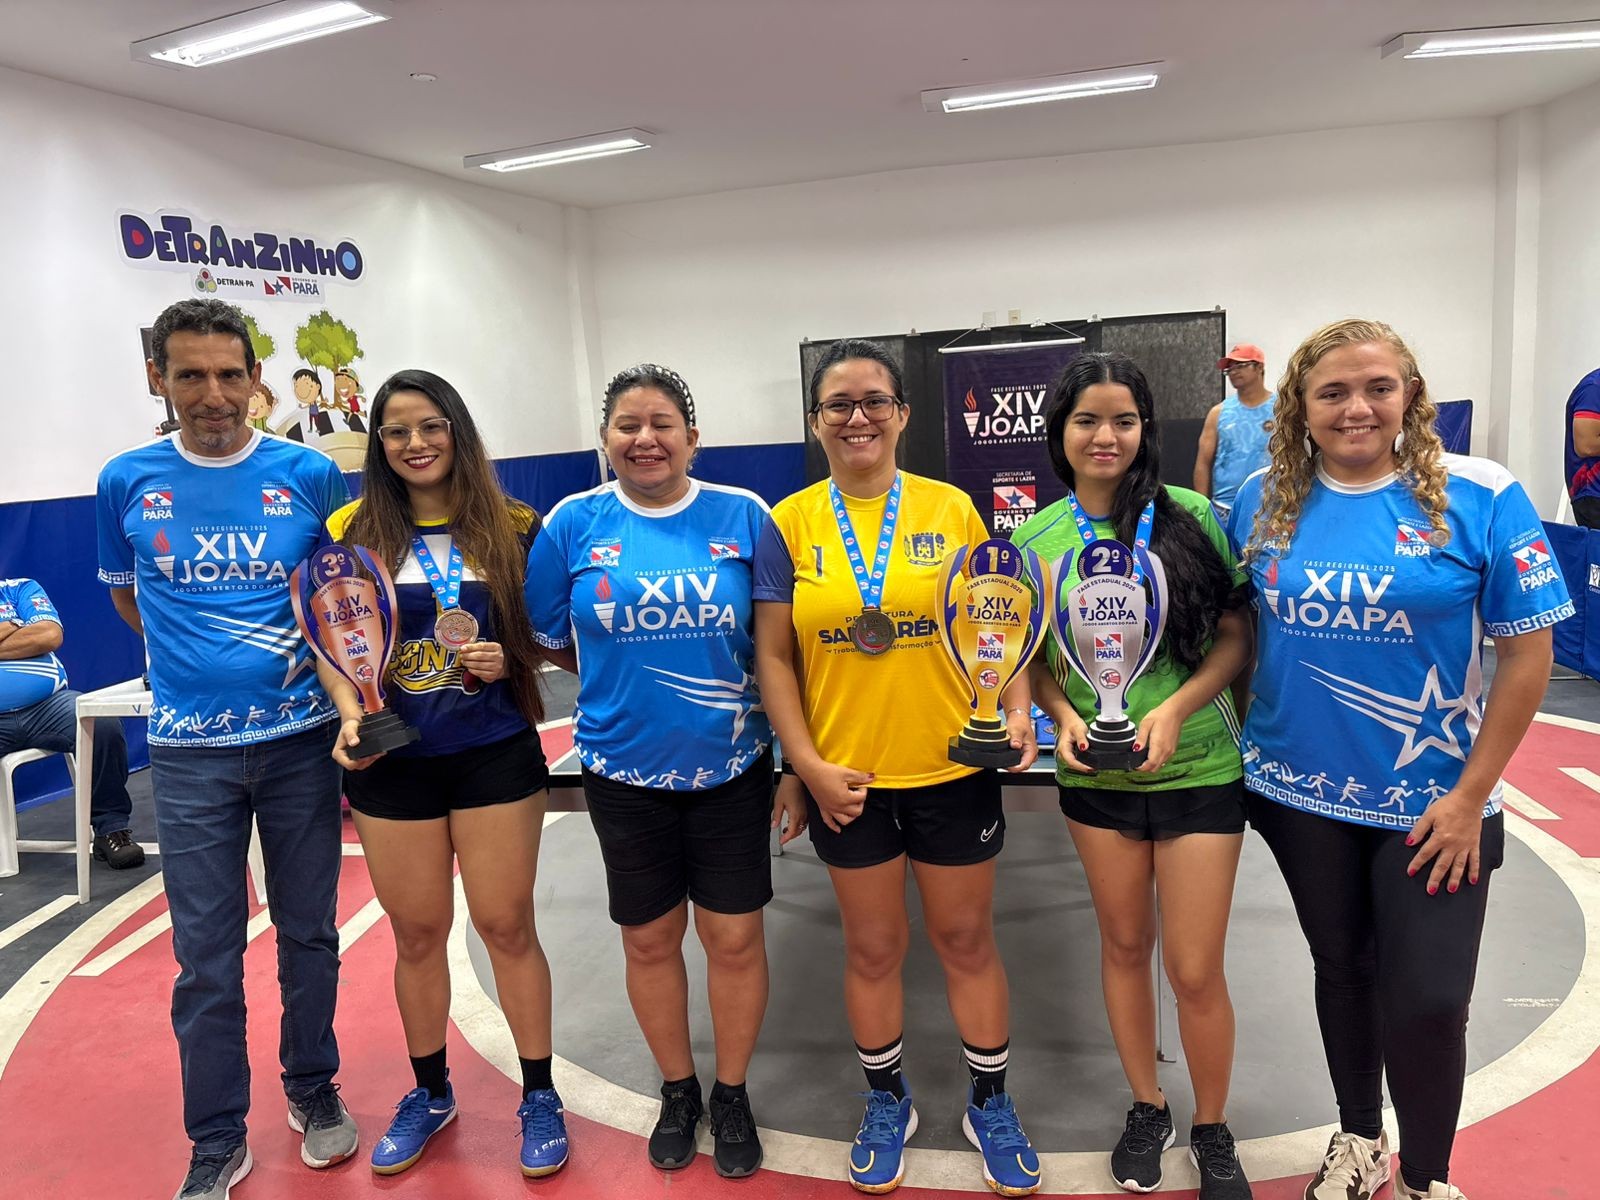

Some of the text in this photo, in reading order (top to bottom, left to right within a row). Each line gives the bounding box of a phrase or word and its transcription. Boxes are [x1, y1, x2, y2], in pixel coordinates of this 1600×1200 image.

[120, 214, 362, 280] DETRANZINHO
[217, 278, 254, 288] DETRAN-PA
[992, 390, 1047, 417] XIV
[979, 414, 1047, 437] JOAP
[193, 532, 268, 560] XIV
[179, 559, 288, 584] JOAPA
[321, 552, 346, 578] 3º
[986, 546, 1010, 573] 1º
[1091, 546, 1120, 573] 2º
[636, 573, 718, 605] XIV
[1299, 568, 1395, 605] XIV
[332, 604, 373, 623] JOAPA
[335, 594, 360, 612] XIV
[974, 607, 1021, 623] JOAPA
[983, 596, 1014, 611] XIV
[1088, 609, 1137, 621] JOAPA
[1096, 596, 1127, 610] XIV
[619, 603, 736, 633] JOAPA
[1282, 596, 1414, 636] JOAPA
[616, 635, 649, 643] JOGOS
[651, 632, 698, 641] ABERTOS
[1310, 631, 1361, 641] ABERTOS
[1365, 635, 1380, 643] DO
